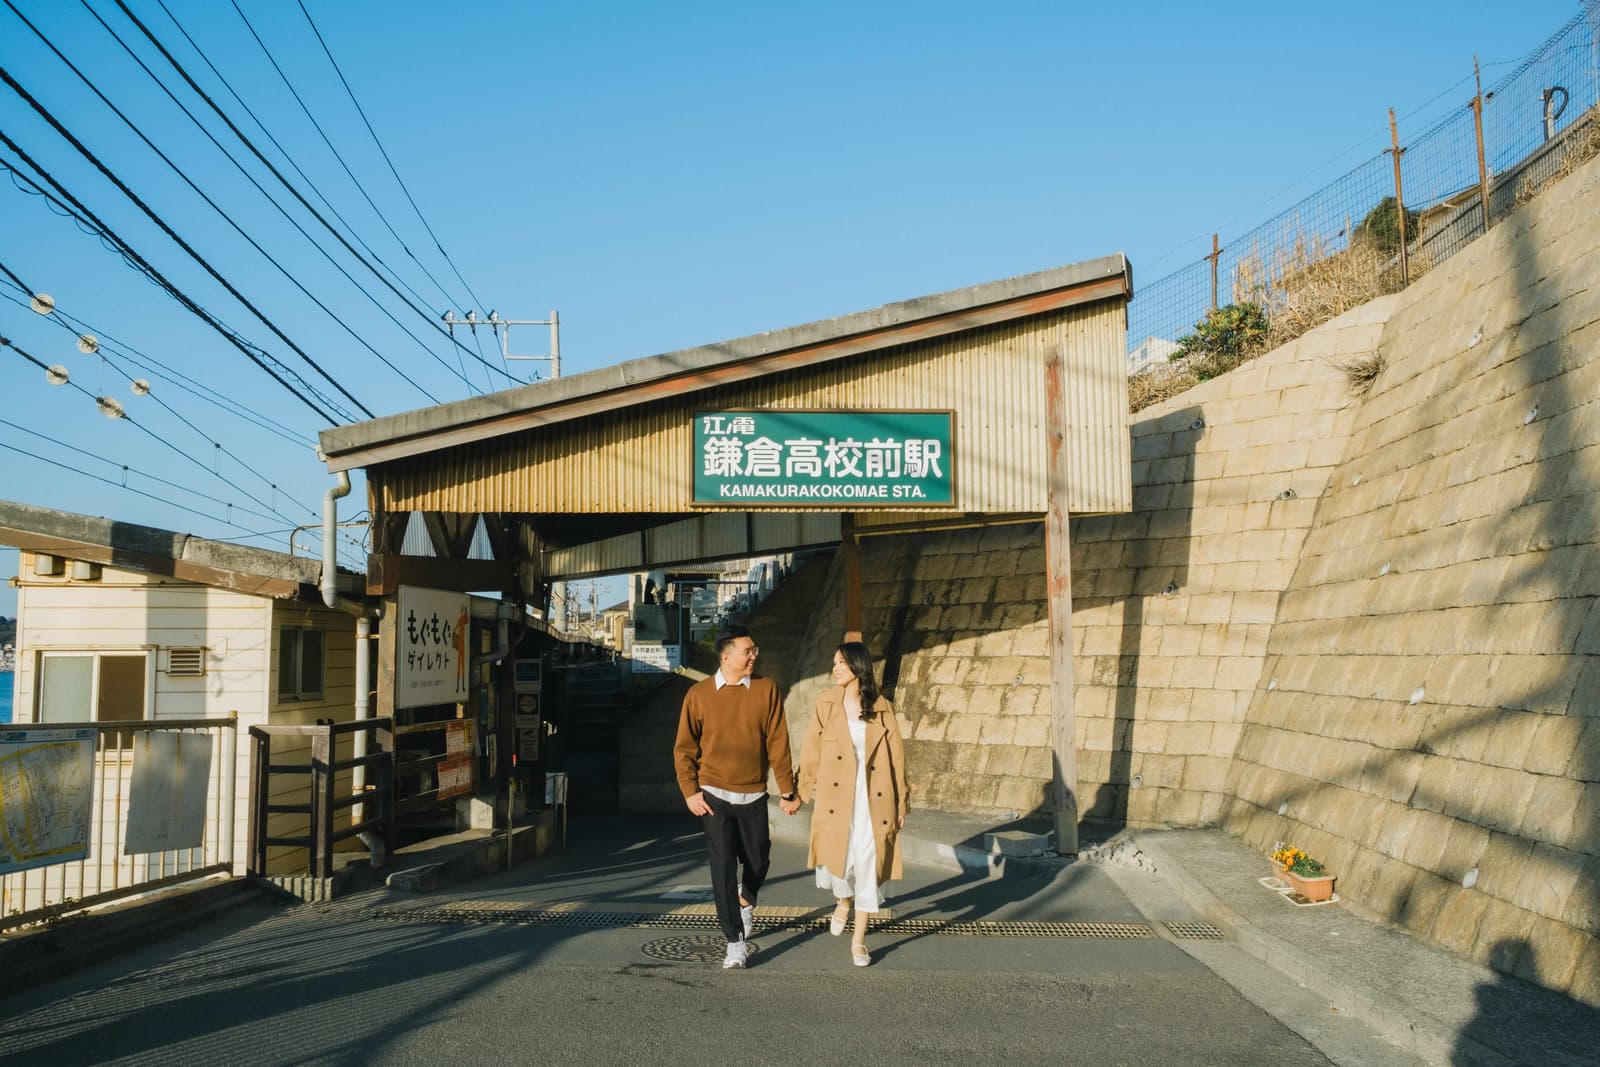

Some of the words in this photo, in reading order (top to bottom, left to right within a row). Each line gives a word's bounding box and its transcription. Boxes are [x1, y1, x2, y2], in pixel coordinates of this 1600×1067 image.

[704, 416, 755, 435] 江ノ電
[703, 436, 943, 478] 鎌倉高校前駅
[720, 484, 888, 498] KAMAKURAKOKOMAE
[892, 485, 927, 498] STA.
[407, 609, 451, 646] もぐもぐ
[407, 650, 450, 672] ダイレクト
